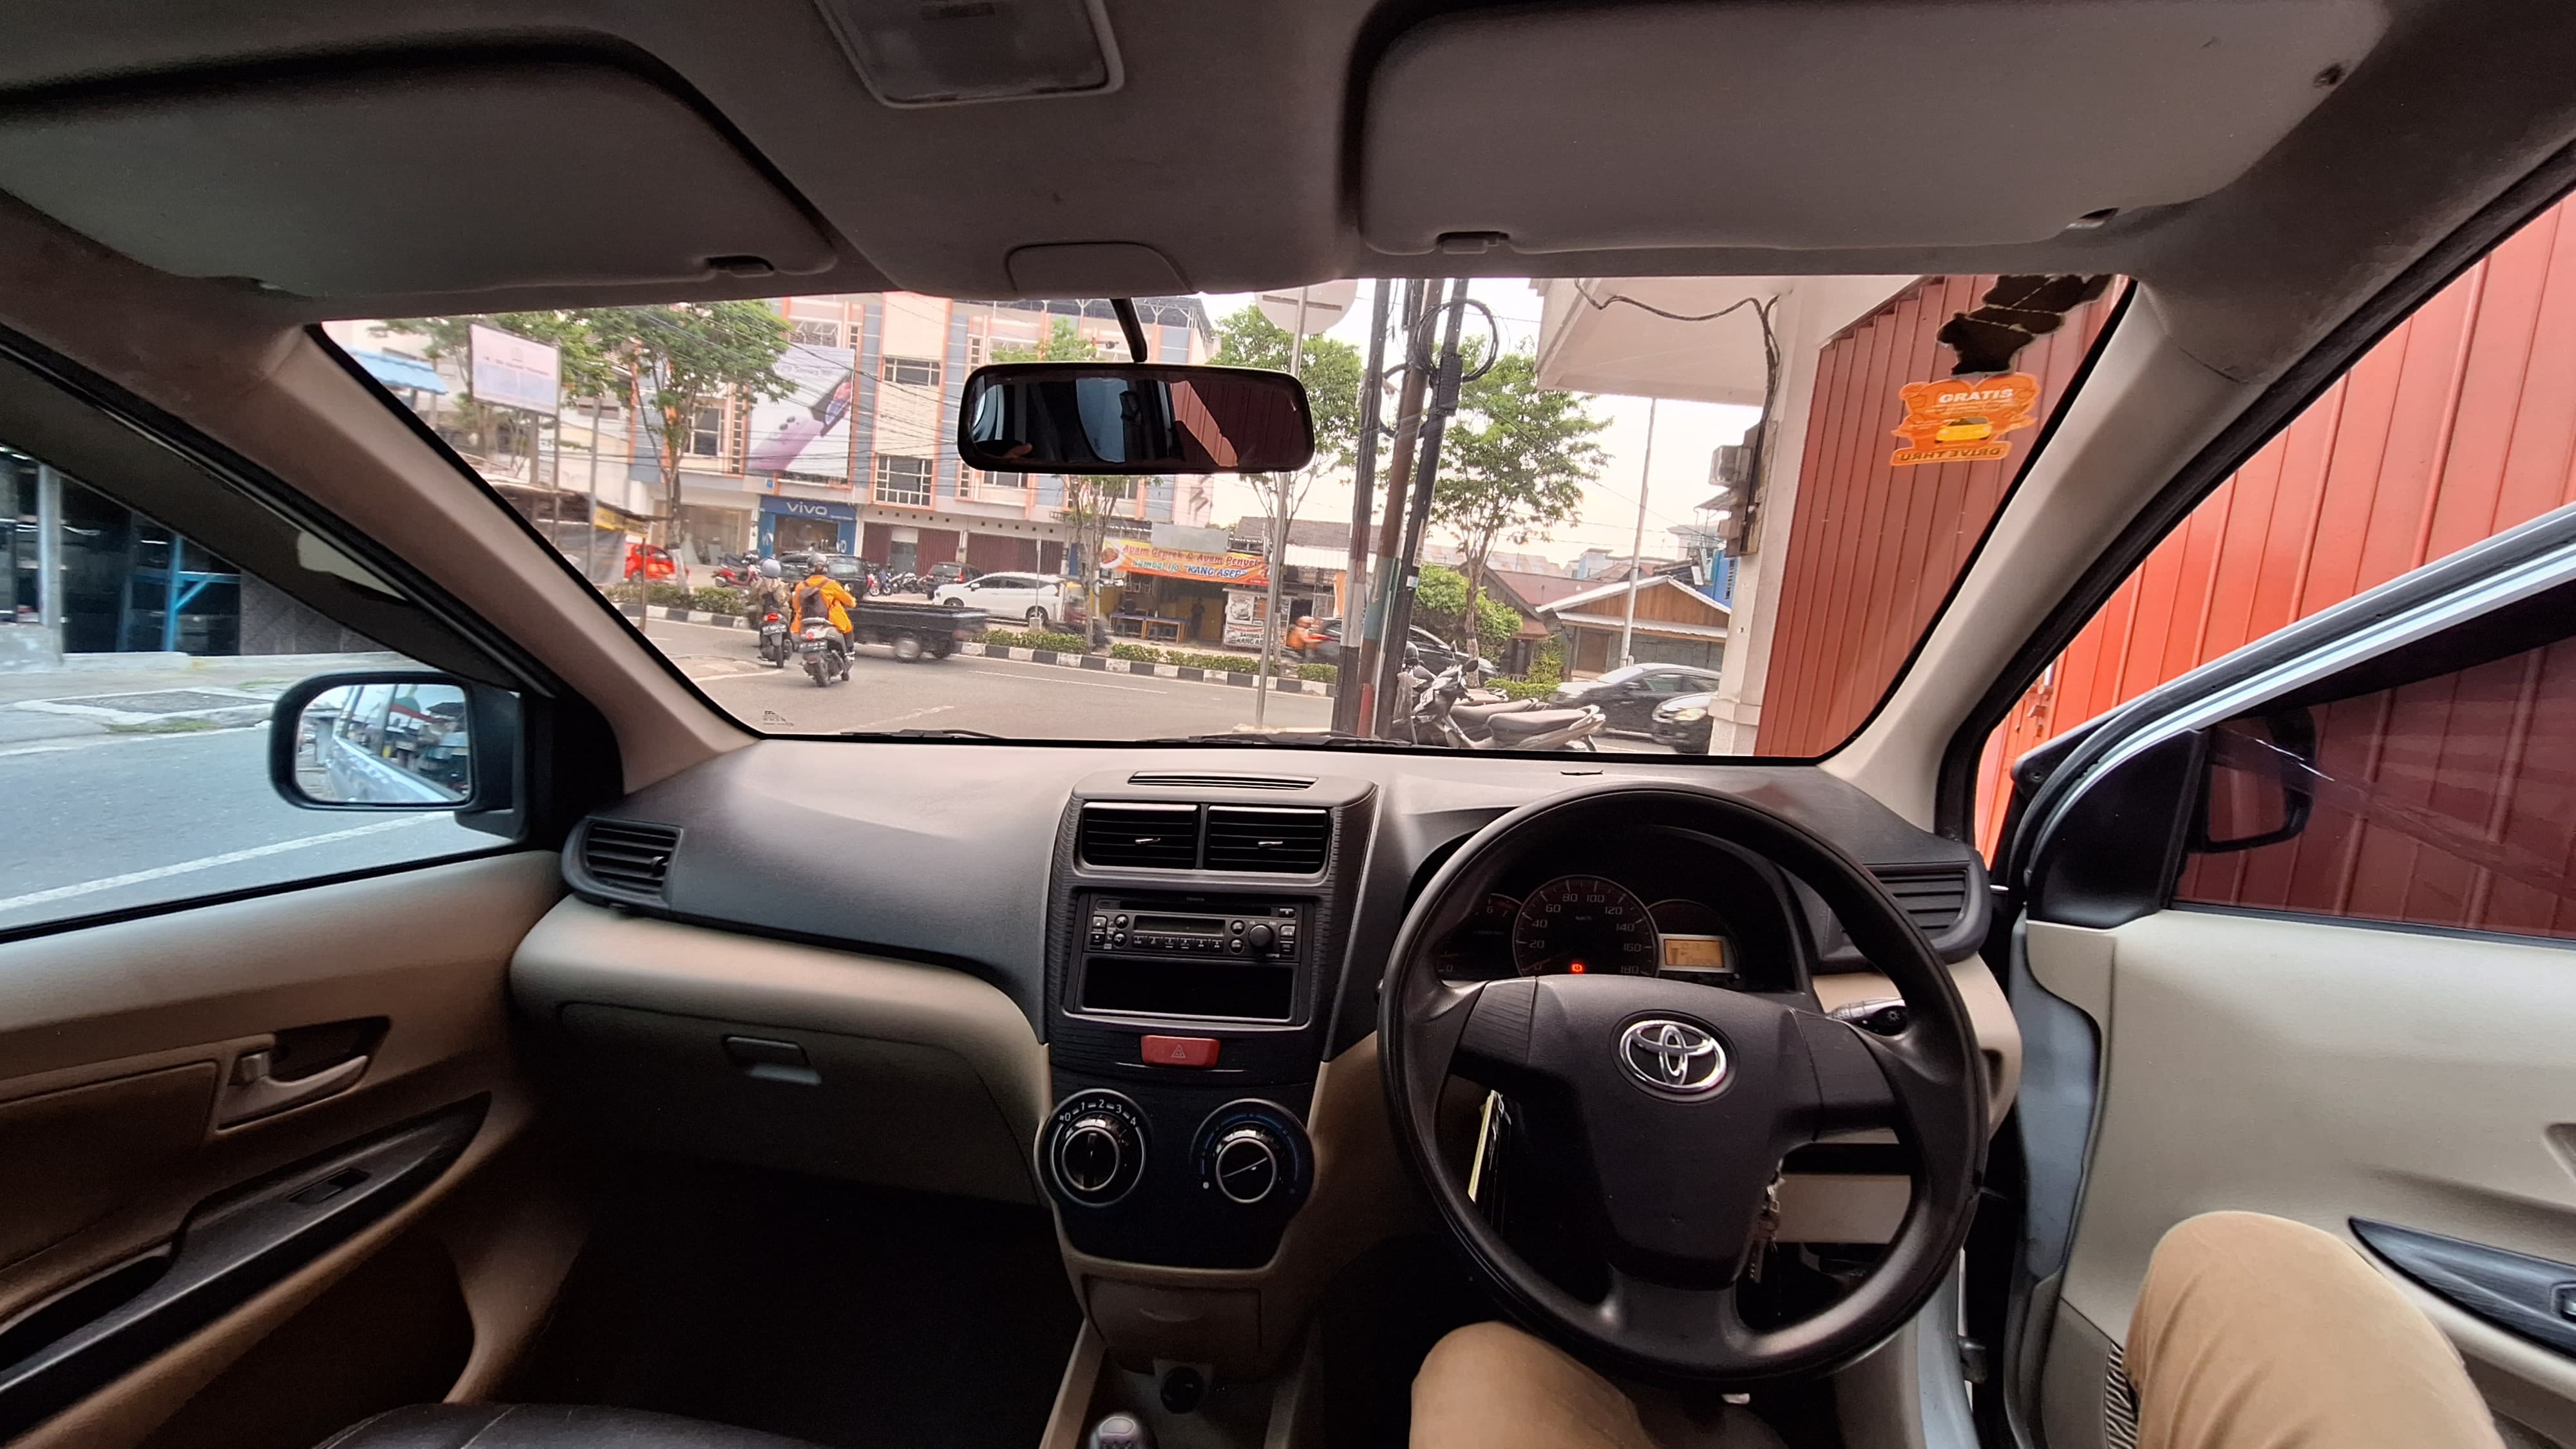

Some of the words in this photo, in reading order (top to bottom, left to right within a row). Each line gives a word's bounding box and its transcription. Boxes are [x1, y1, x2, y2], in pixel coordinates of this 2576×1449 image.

[1938, 388, 2014, 403] GRATIS
[786, 501, 828, 515] vivo
[1122, 544, 1150, 554] Ayam
[1151, 547, 1183, 560] Geprek
[1197, 554, 1224, 564] Ayam
[1226, 556, 1258, 567] Penyet
[1133, 558, 1165, 570] Sambal
[1562, 893, 1578, 902] 80
[1587, 894, 1605, 903] 100
[1546, 904, 1561, 913] 60
[1605, 906, 1622, 914] 120
[1531, 919, 1548, 928] 40
[1529, 940, 1545, 949] 20
[1624, 943, 1642, 952] 160
[1620, 965, 1639, 974] 180
[1065, 1112, 1071, 1121] 0
[1081, 1102, 1085, 1111] 1
[1099, 1099, 1104, 1108] 2
[1116, 1104, 1122, 1113] 3
[1130, 1117, 1136, 1126] 4
